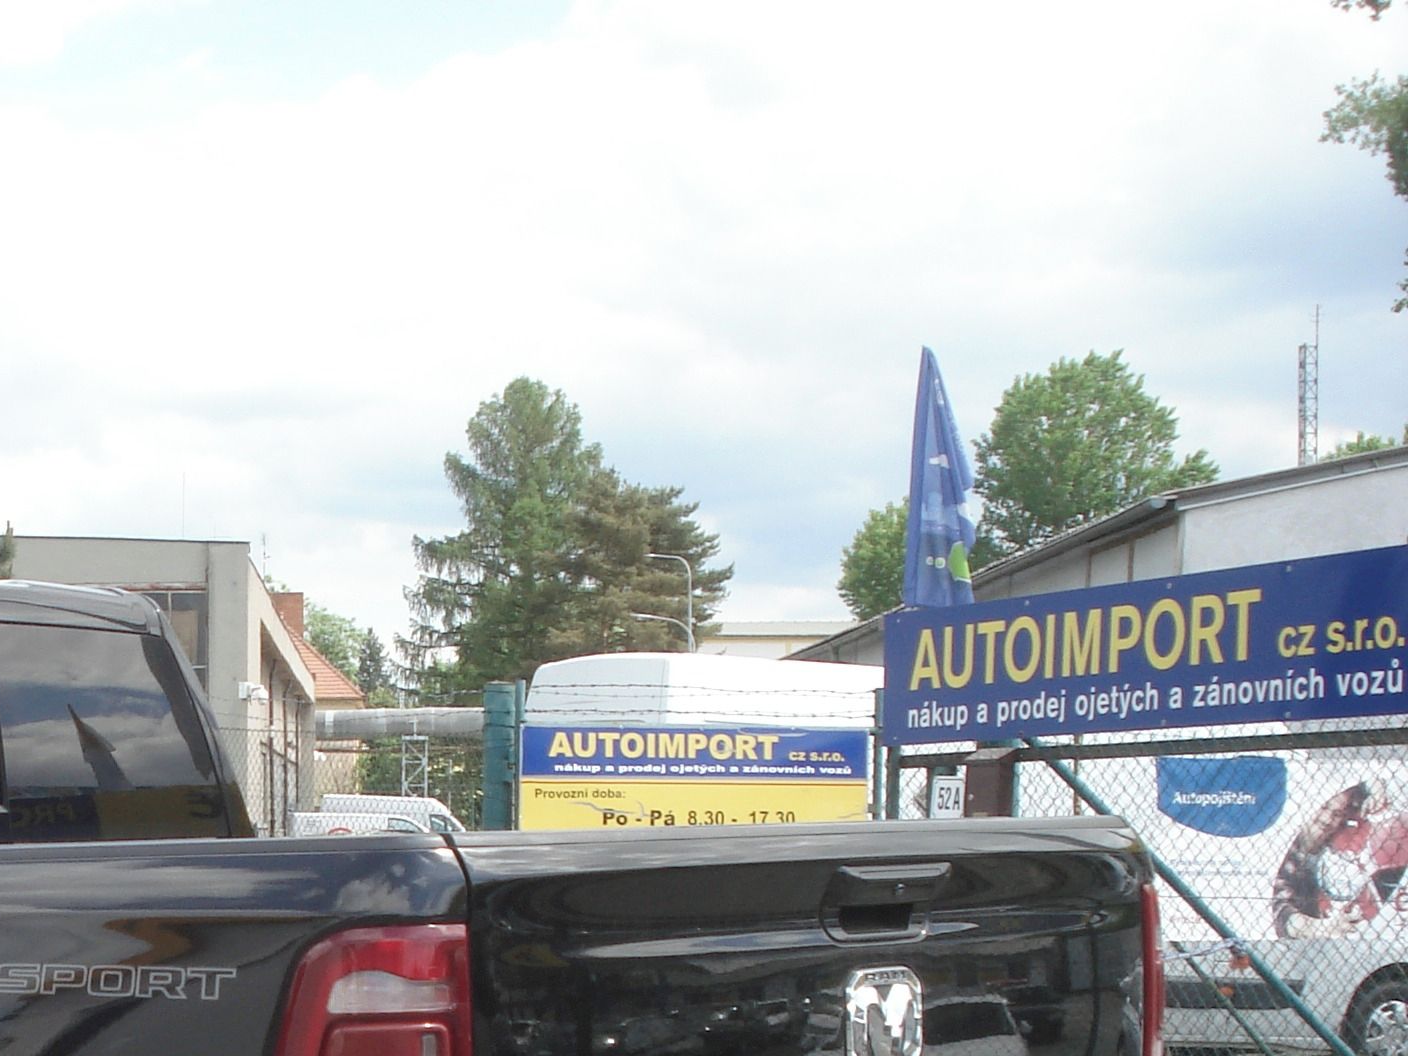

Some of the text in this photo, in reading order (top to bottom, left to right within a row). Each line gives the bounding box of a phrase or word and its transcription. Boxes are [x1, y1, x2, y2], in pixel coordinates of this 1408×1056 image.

[909, 588, 1406, 691] AUTOIMPORT cz s.r.o.
[908, 658, 1403, 731] nákup a prodej ojetých a zánovních vozů
[548, 731, 779, 761] AUTOIMPORT
[809, 751, 845, 762] s.r.o.
[554, 763, 600, 774] nákup
[618, 764, 666, 774] prodej
[670, 764, 725, 775] ojetých
[742, 764, 815, 775] zánovních
[819, 765, 852, 775] vozů
[592, 788, 626, 799] doba:
[602, 808, 628, 825] Po
[650, 809, 675, 826] Pá
